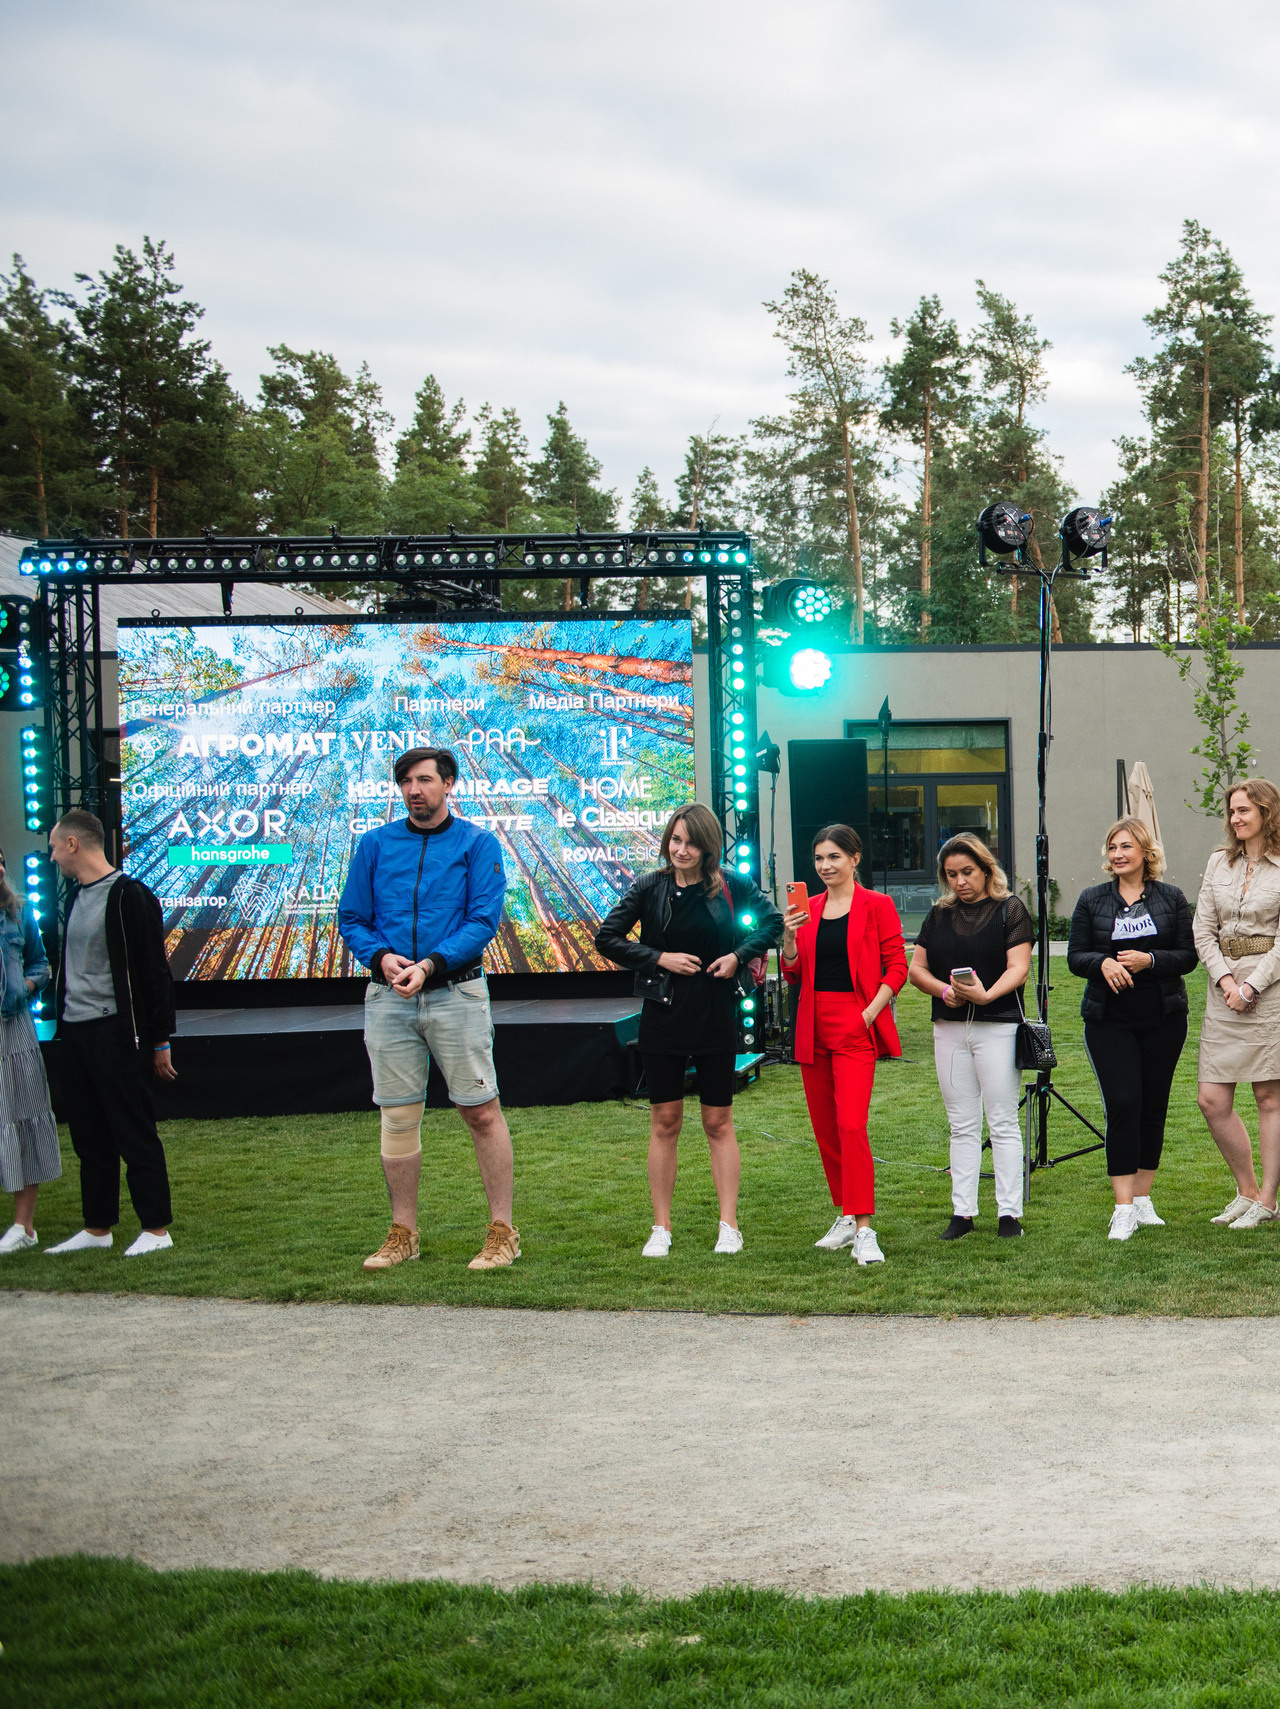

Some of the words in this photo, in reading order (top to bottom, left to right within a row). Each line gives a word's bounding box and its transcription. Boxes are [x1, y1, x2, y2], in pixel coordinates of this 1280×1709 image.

[131, 700, 253, 719] Генеральний
[259, 701, 336, 718] партнер
[395, 697, 485, 715] Партнери
[529, 694, 584, 711] Медіа
[590, 693, 680, 712] Партнери
[177, 732, 337, 758] АГРОМАТ
[350, 730, 431, 750] VENIS
[131, 781, 230, 799] Офіційний
[236, 781, 313, 799] партнер
[580, 777, 652, 799] HOME
[168, 809, 287, 838] AXOR
[557, 807, 577, 828] le
[581, 806, 675, 831] Classique
[191, 845, 270, 863] hansgrohe
[562, 846, 661, 863] ROYALDESIG
[159, 895, 228, 909] ганізатор
